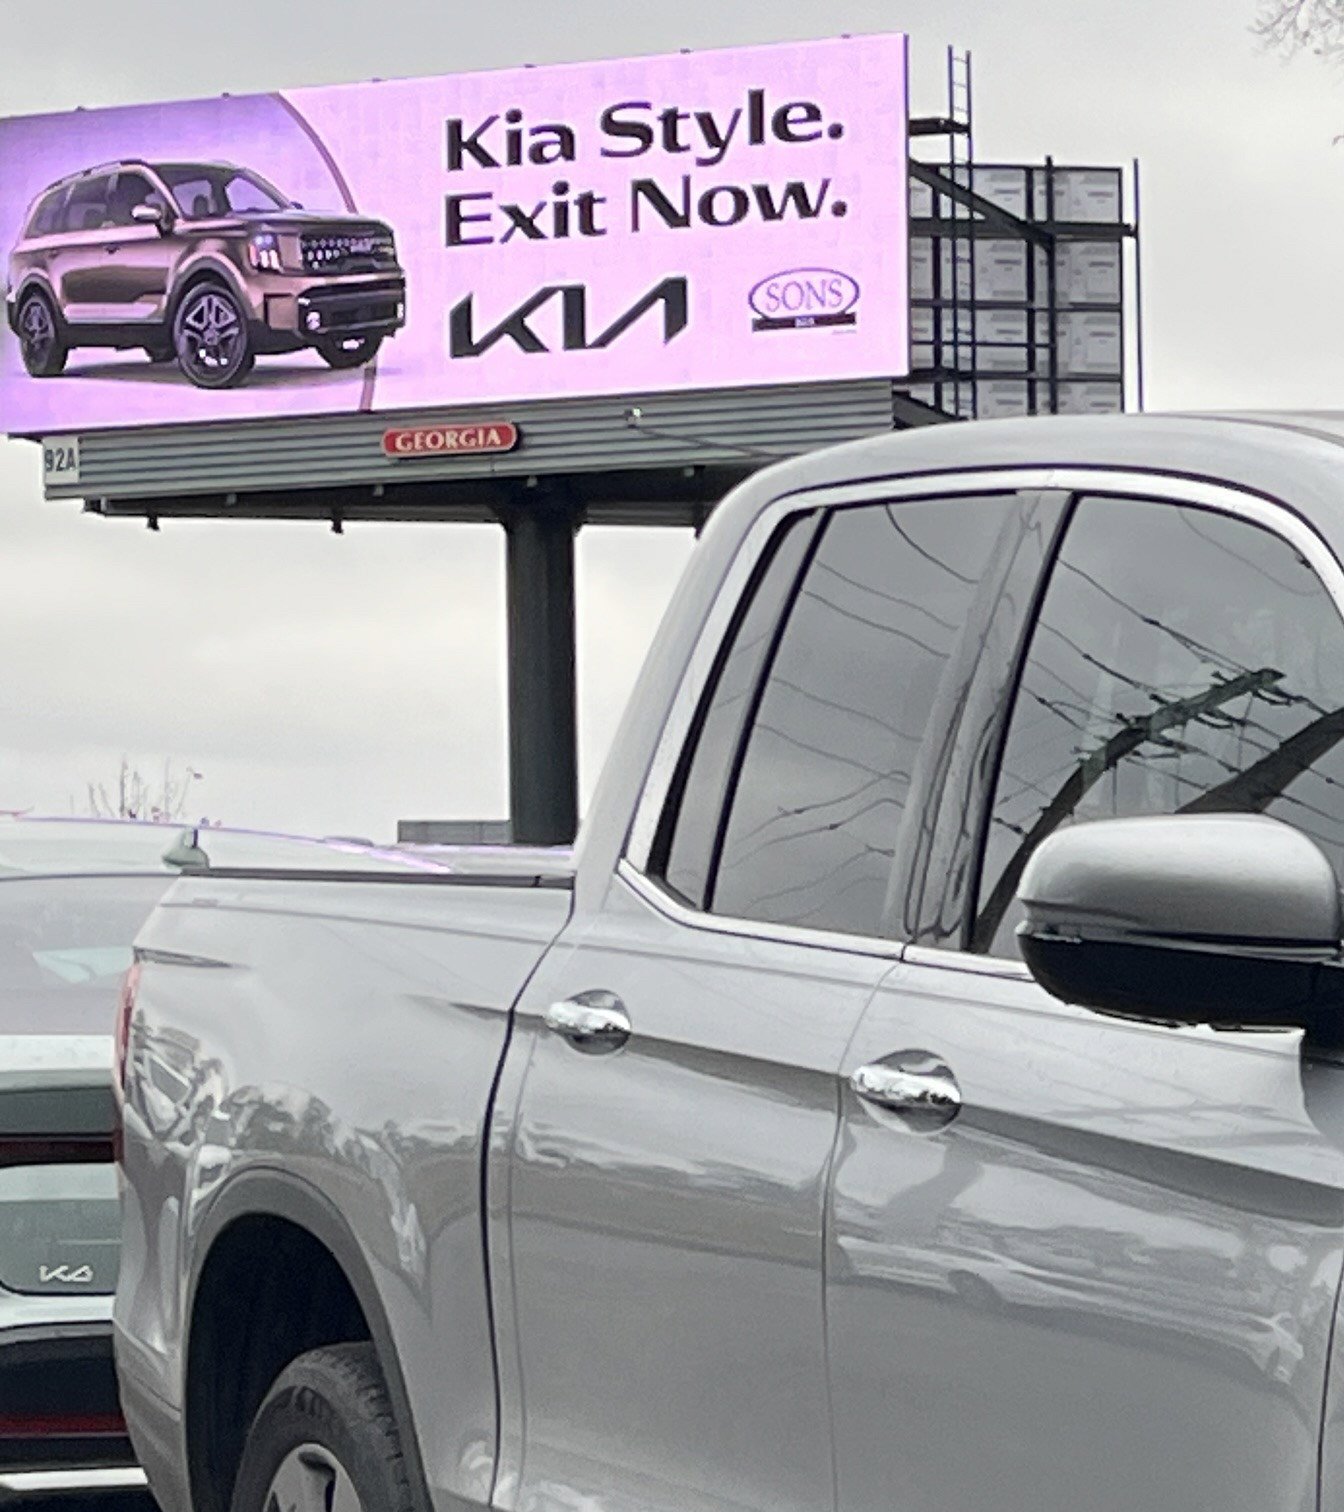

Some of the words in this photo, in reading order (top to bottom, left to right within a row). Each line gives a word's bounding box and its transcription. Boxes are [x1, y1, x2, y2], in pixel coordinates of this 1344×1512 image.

[446, 108, 576, 172] Kia
[599, 88, 844, 167] Style.
[445, 180, 607, 247] Exit
[631, 175, 848, 233] Now.
[449, 276, 688, 359] KIA
[766, 279, 843, 312] SONS
[44, 447, 76, 472] 92A
[395, 428, 501, 452] GEORGIA
